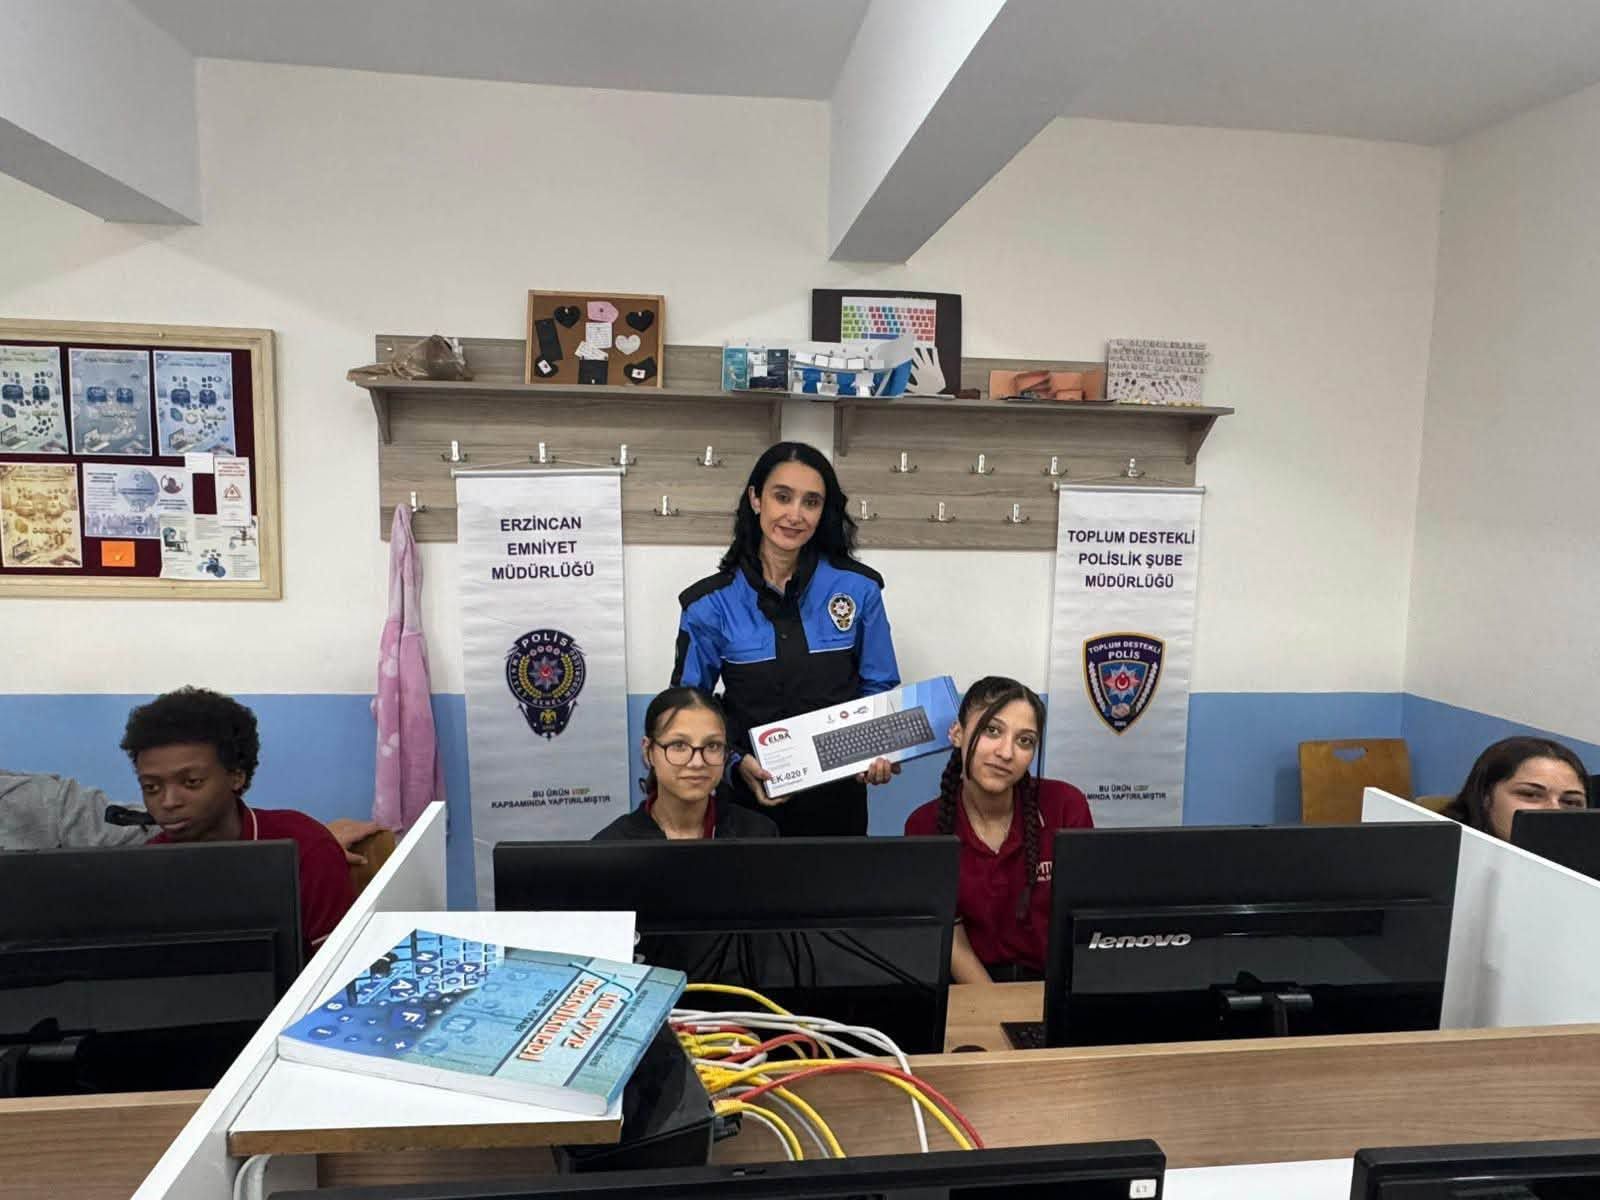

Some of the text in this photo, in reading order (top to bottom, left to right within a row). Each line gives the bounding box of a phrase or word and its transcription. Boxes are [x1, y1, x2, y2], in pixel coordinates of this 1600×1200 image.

[500, 515, 582, 532] ERZİNCAN
[1067, 529, 1195, 545] TOPLUM DESTEKLİ
[507, 539, 577, 556] EMNİYET
[1078, 550, 1183, 569] POLİSLİK ŞUBE
[491, 561, 594, 580] MÜDÜRLÜĞÜ
[1085, 573, 1174, 588] MÜDÜRLÜĞÜ
[1088, 641, 1121, 654] TOPLUM
[768, 732, 792, 743] ELBA
[802, 767, 808, 776] F
[532, 790, 545, 798] BU
[546, 787, 570, 797] ÜRÜN
[491, 799, 546, 809] KAPSAMINDA
[1088, 931, 1192, 949] lenovo
